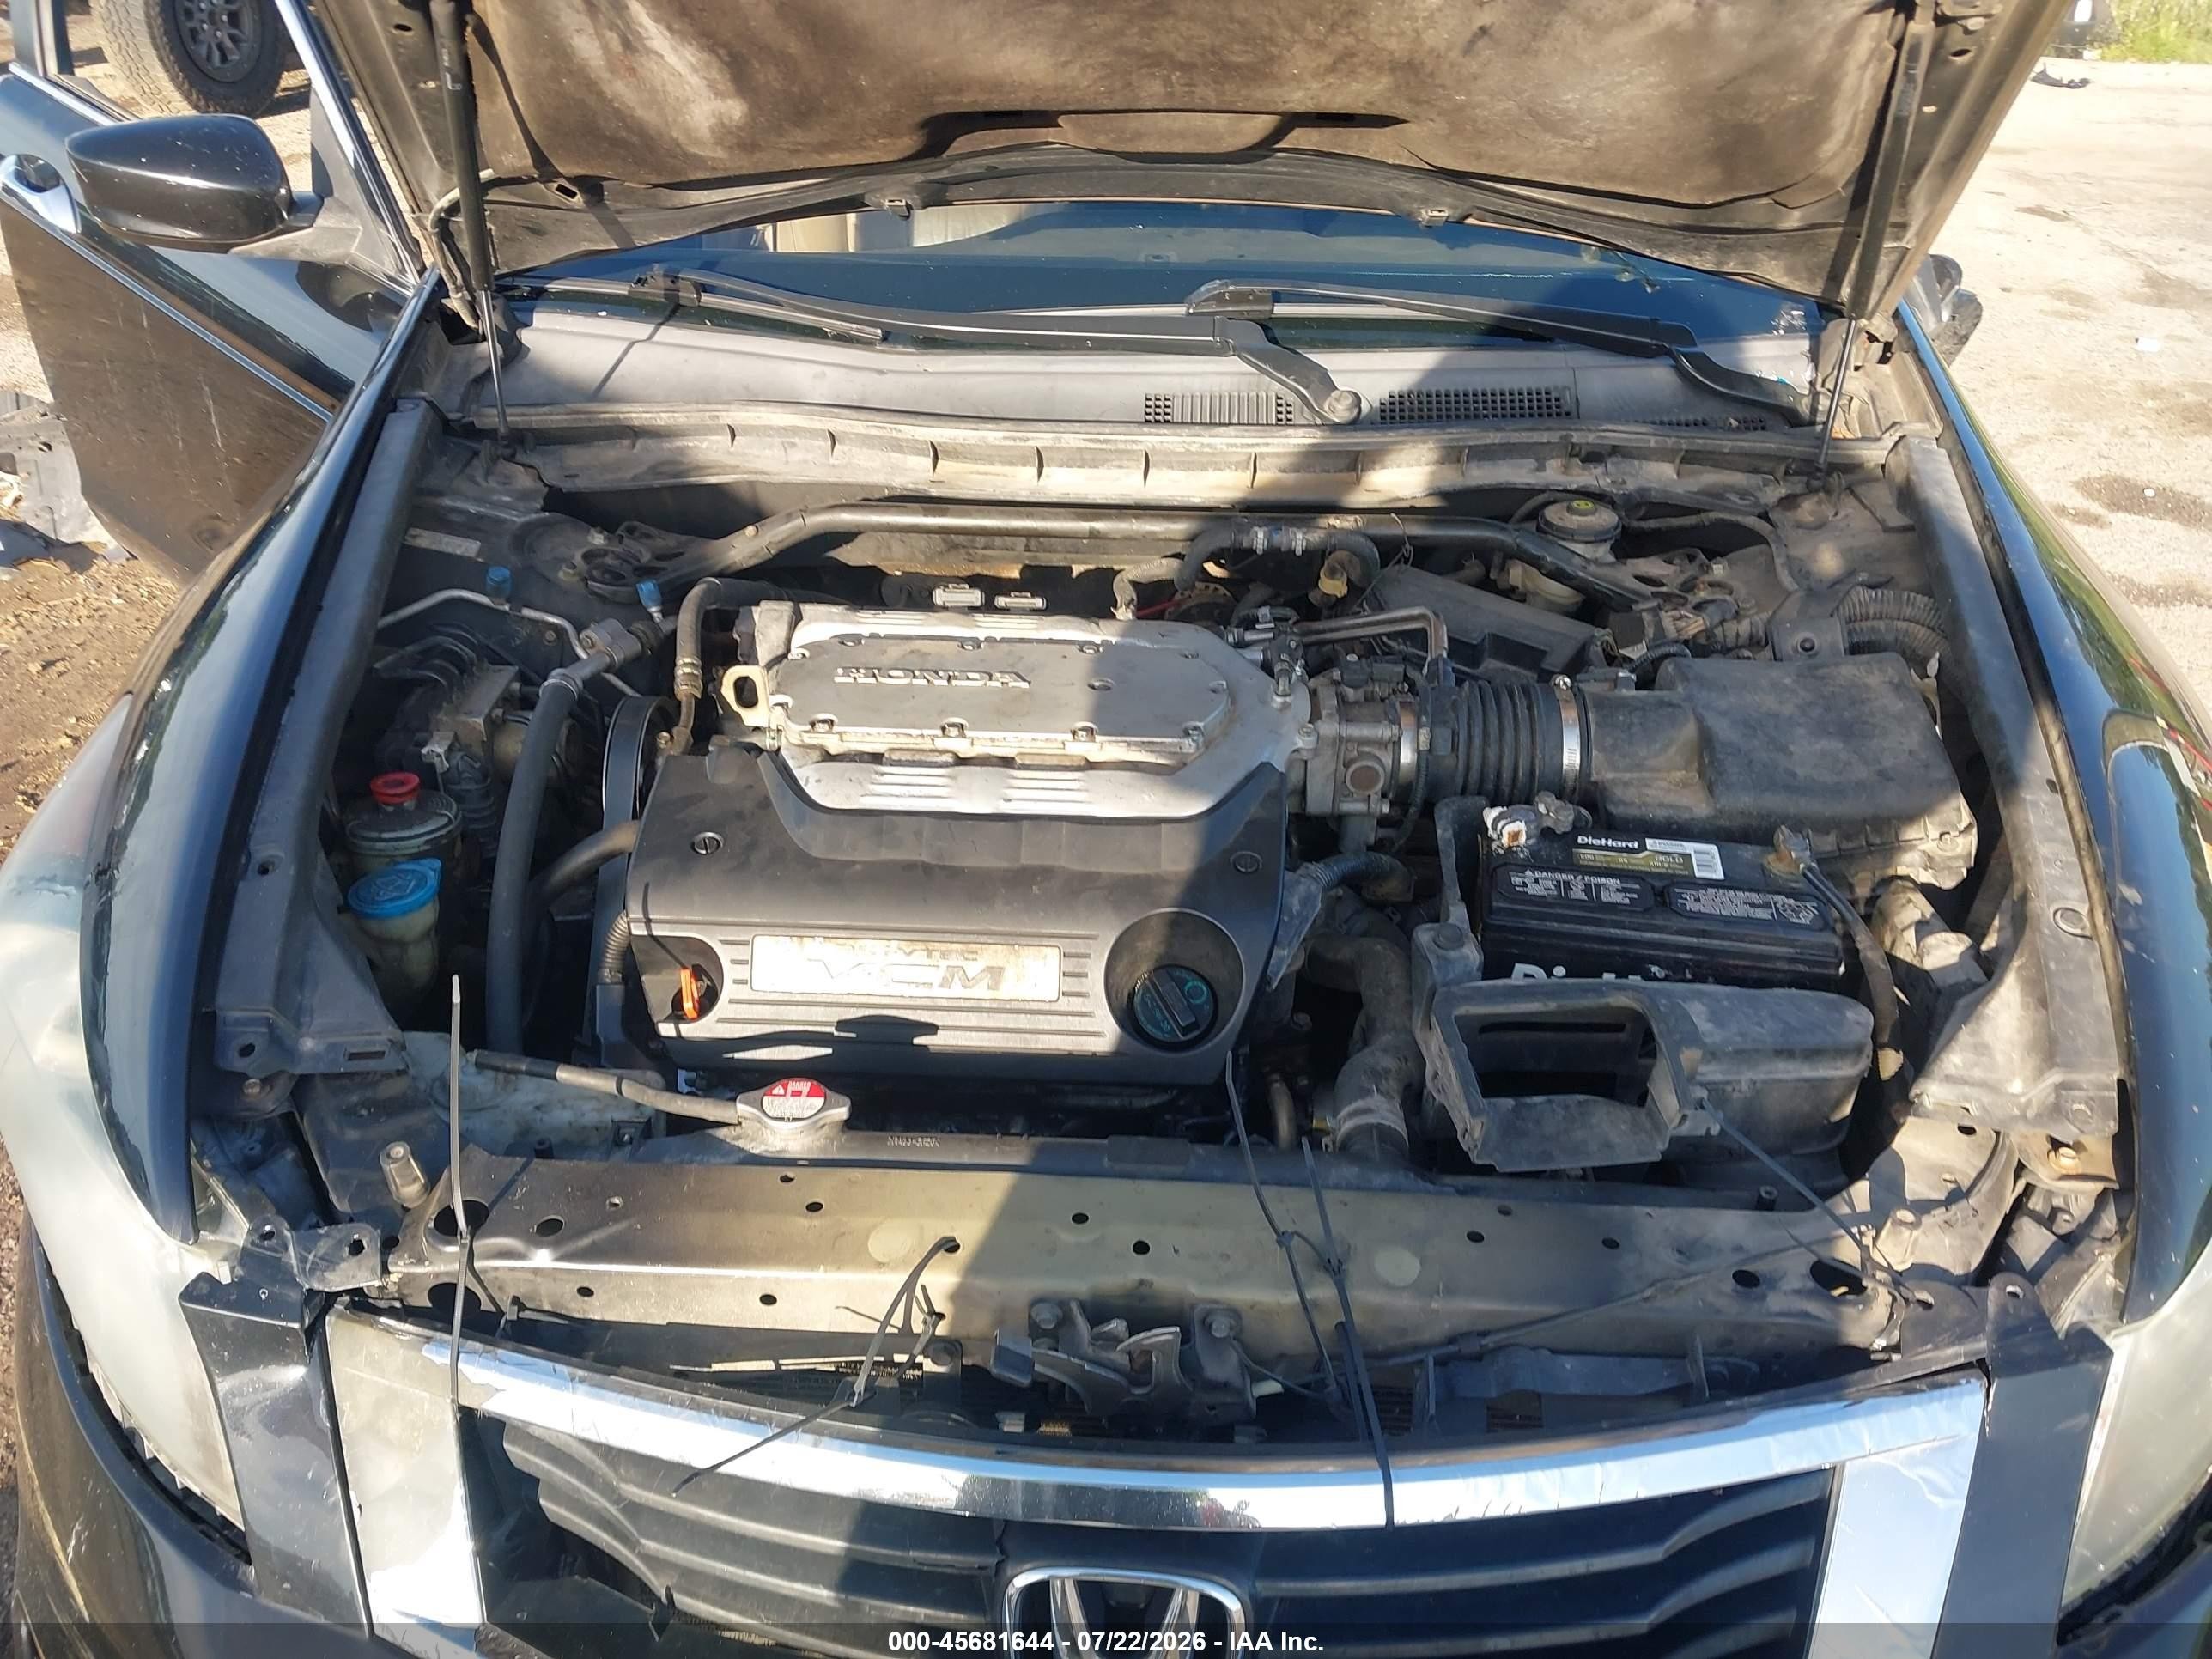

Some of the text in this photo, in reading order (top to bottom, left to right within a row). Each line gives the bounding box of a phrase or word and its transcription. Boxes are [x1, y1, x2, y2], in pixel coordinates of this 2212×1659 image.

[834, 667, 1030, 688] HONDA
[1577, 836, 1638, 849] DieHard
[1534, 870, 1574, 881] DANGER
[1584, 875, 1621, 885] POISON
[806, 957, 1006, 992] VCM
